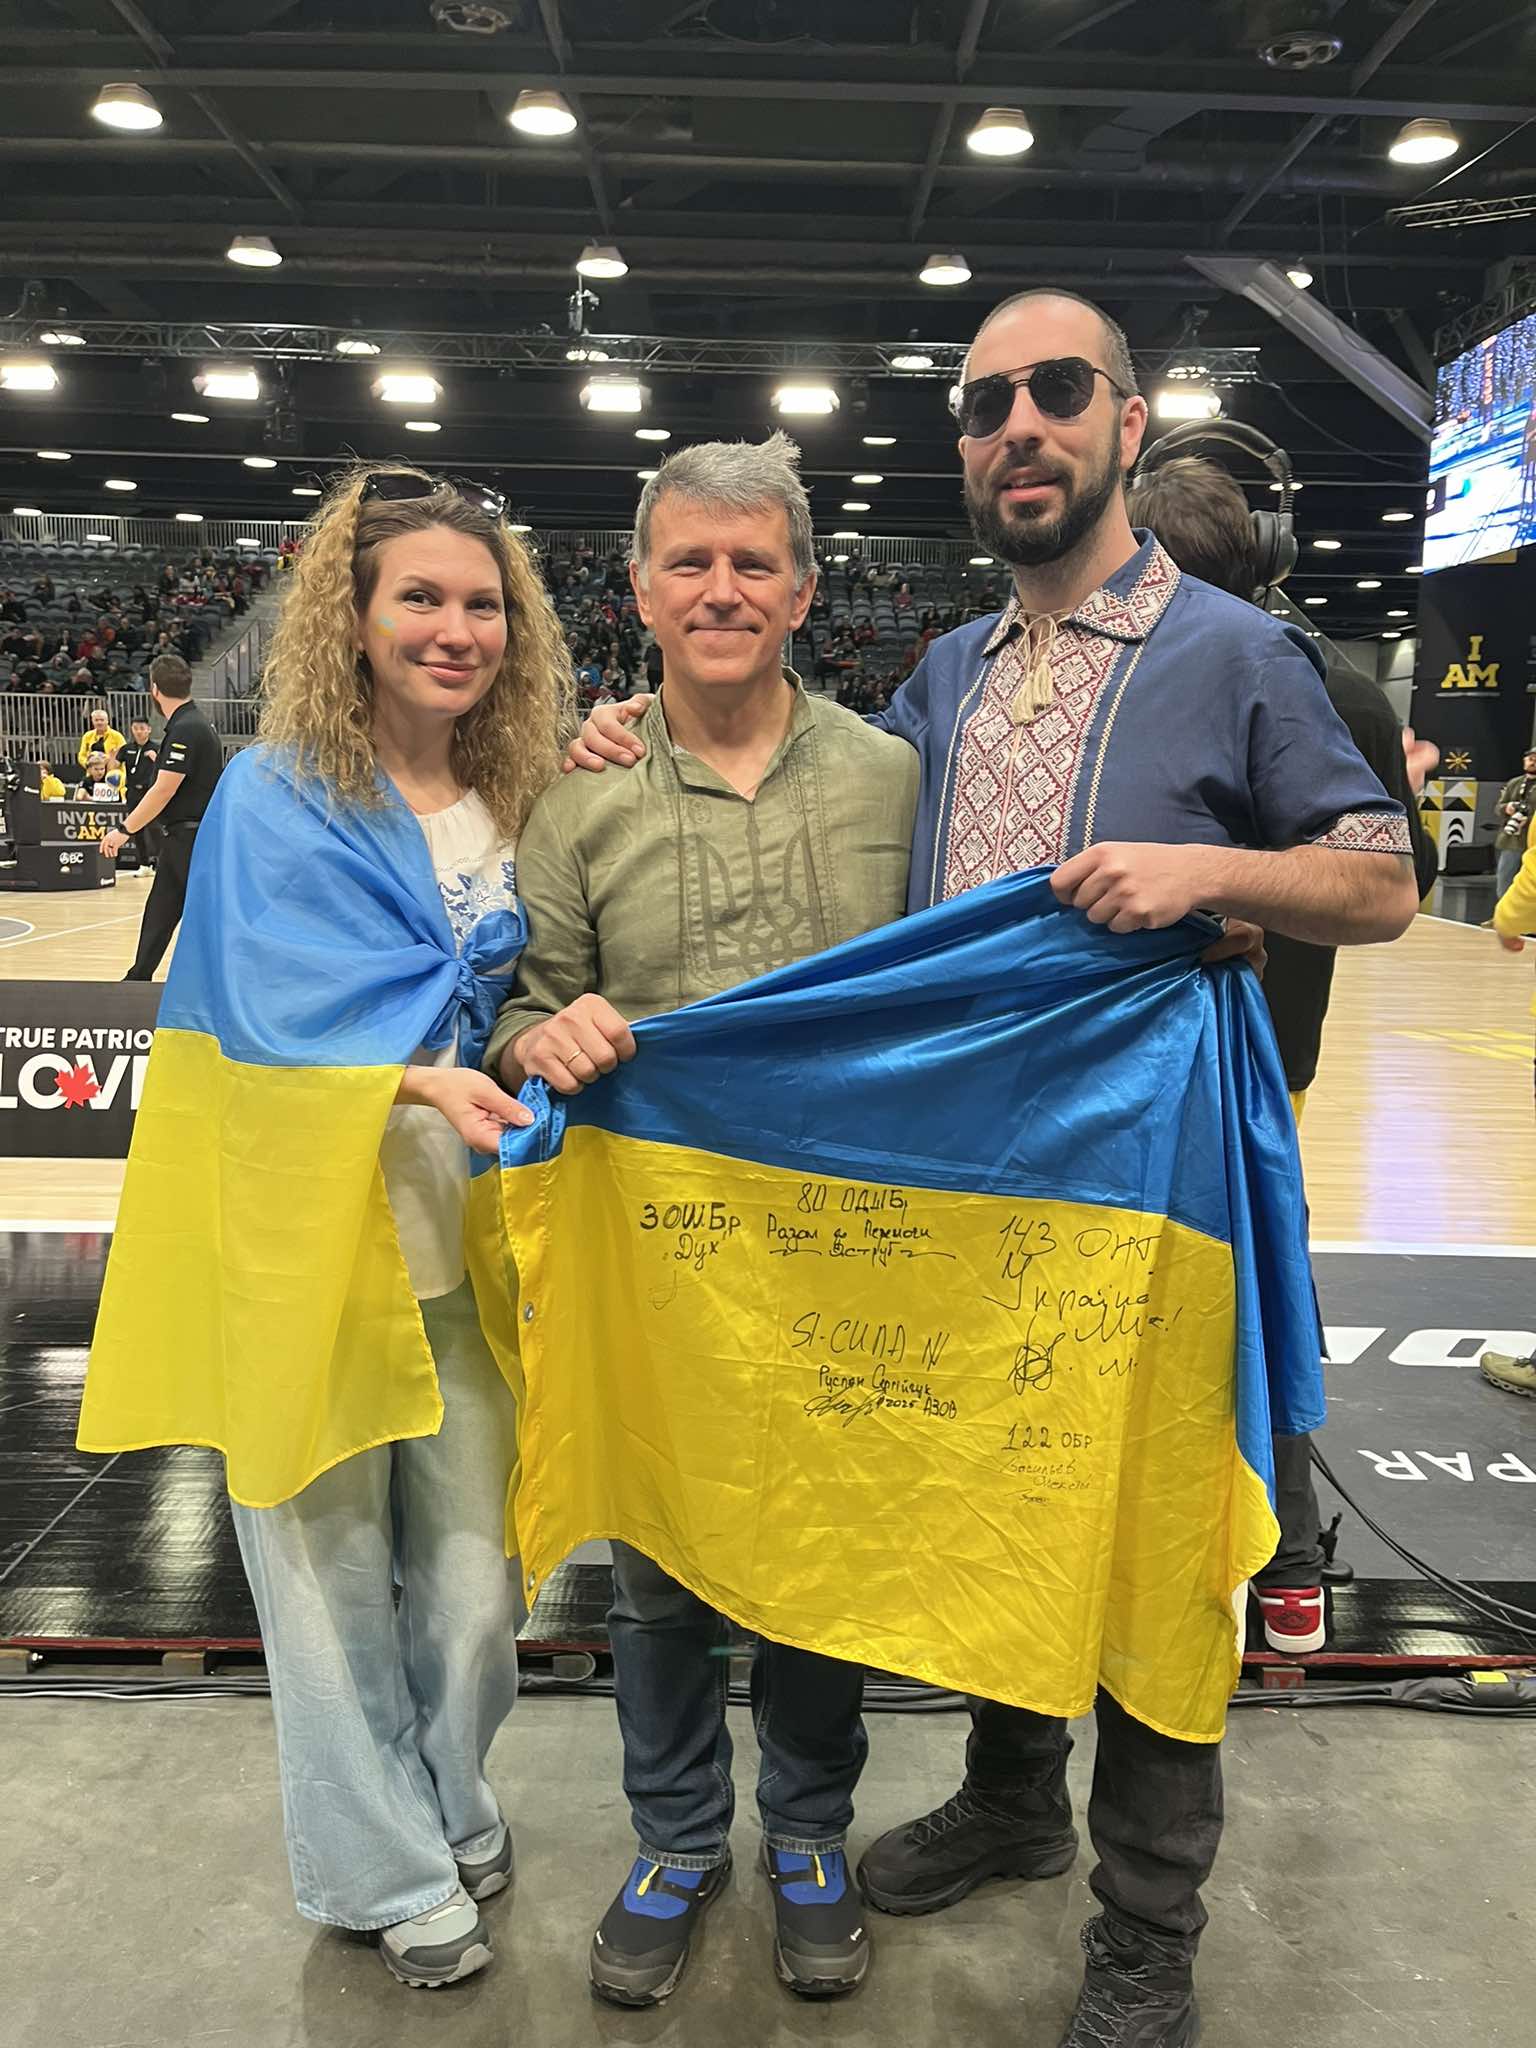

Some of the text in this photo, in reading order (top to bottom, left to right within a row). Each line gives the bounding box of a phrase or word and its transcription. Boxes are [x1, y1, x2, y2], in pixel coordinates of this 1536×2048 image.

[1467, 635, 1483, 661] I
[1441, 663, 1500, 688] AM
[61, 1028, 154, 1050] PATRIO
[997, 1216, 1057, 1257] 143
